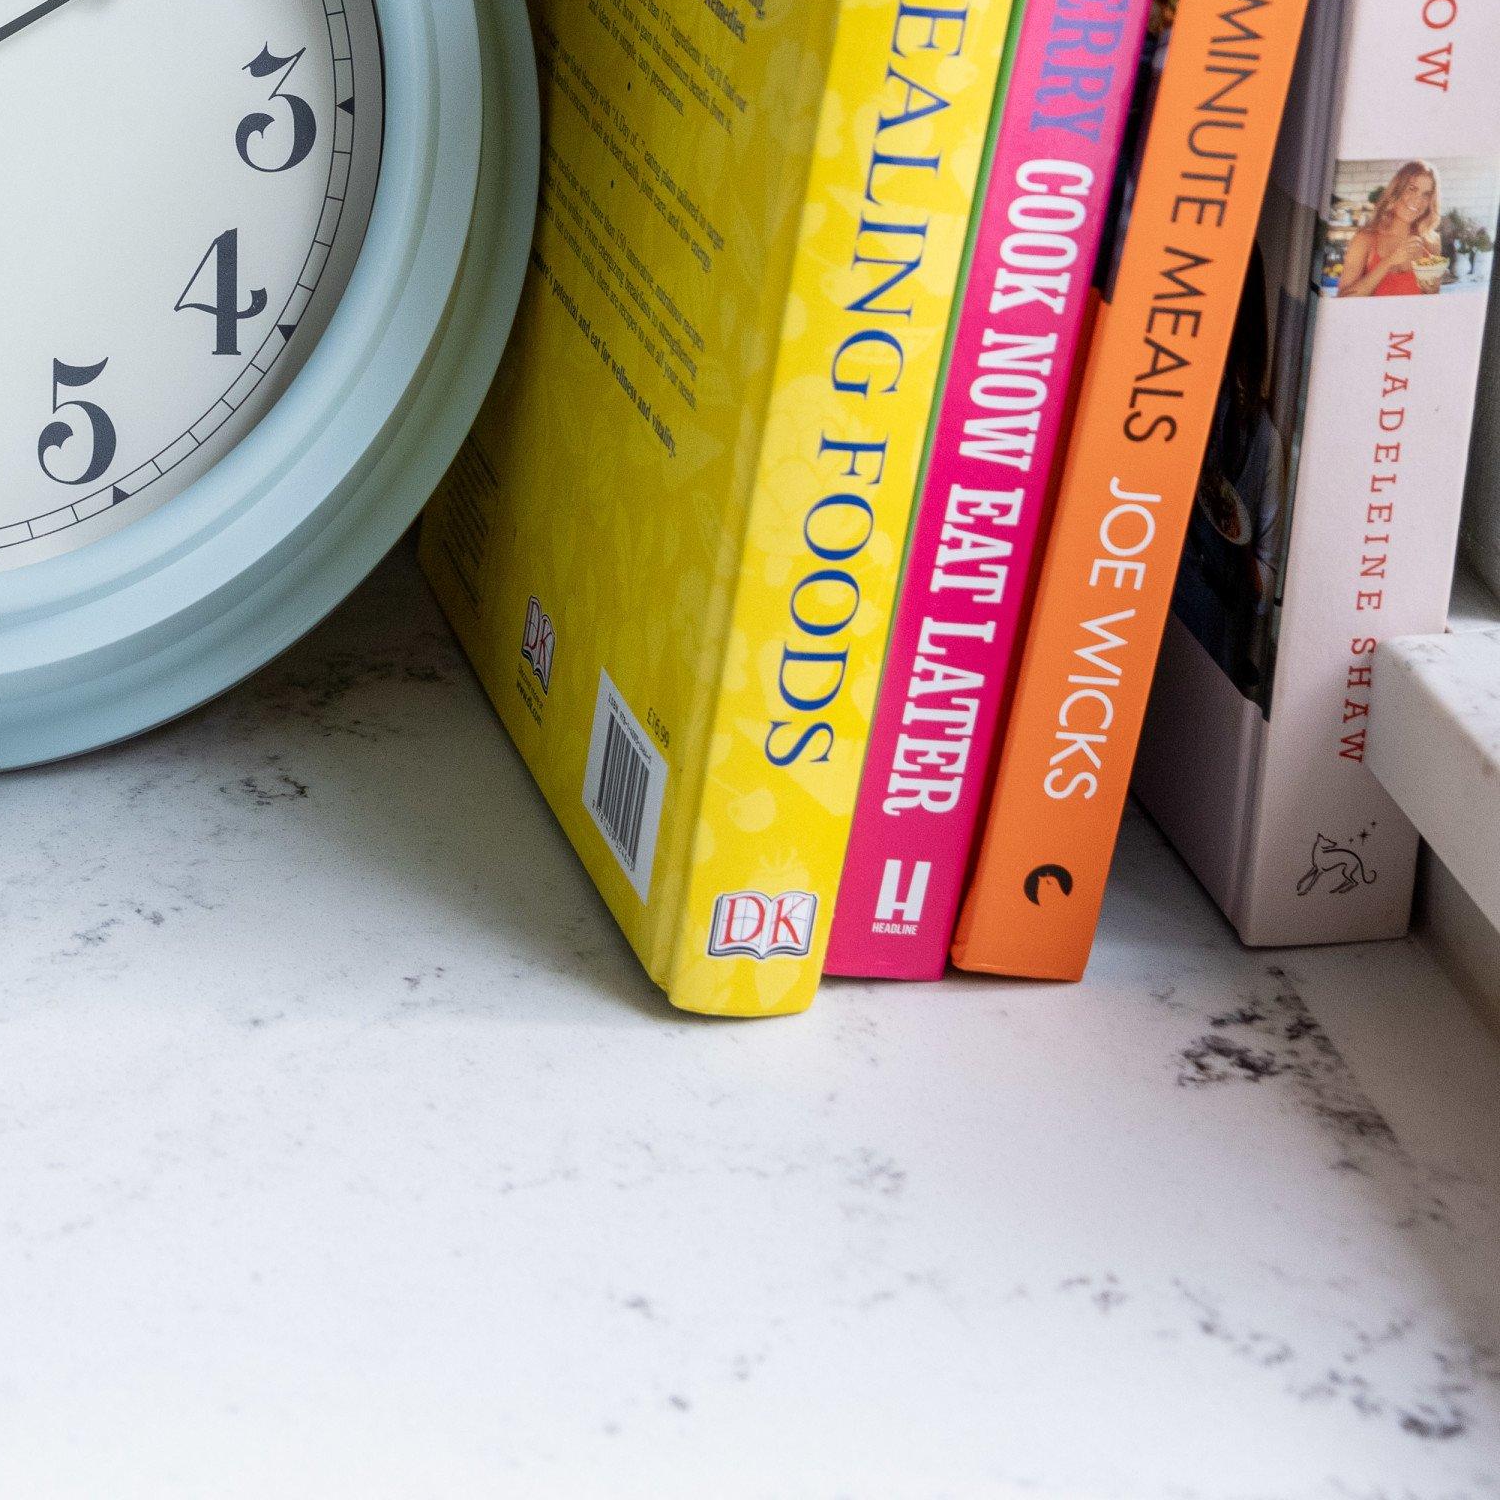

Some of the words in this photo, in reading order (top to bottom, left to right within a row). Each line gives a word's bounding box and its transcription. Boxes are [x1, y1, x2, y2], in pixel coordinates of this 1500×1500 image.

[235, 41, 317, 173] 3
[174, 227, 268, 357] 4
[989, 158, 1094, 315] COOK
[959, 330, 1057, 473] NOW
[1123, 245, 1214, 446] MEALS
[37, 356, 117, 486] 5
[1355, 330, 1416, 613] MADELEINE
[764, 429, 889, 768] FOODS
[930, 482, 1025, 605] EAT
[1089, 476, 1162, 591] JOE
[646, 702, 670, 756] £16.99
[882, 617, 995, 818] LATER
[1043, 608, 1136, 801] WICKS
[1338, 636, 1377, 764] SHAW
[718, 894, 807, 946] DK
[871, 921, 919, 936] HEADLINE
